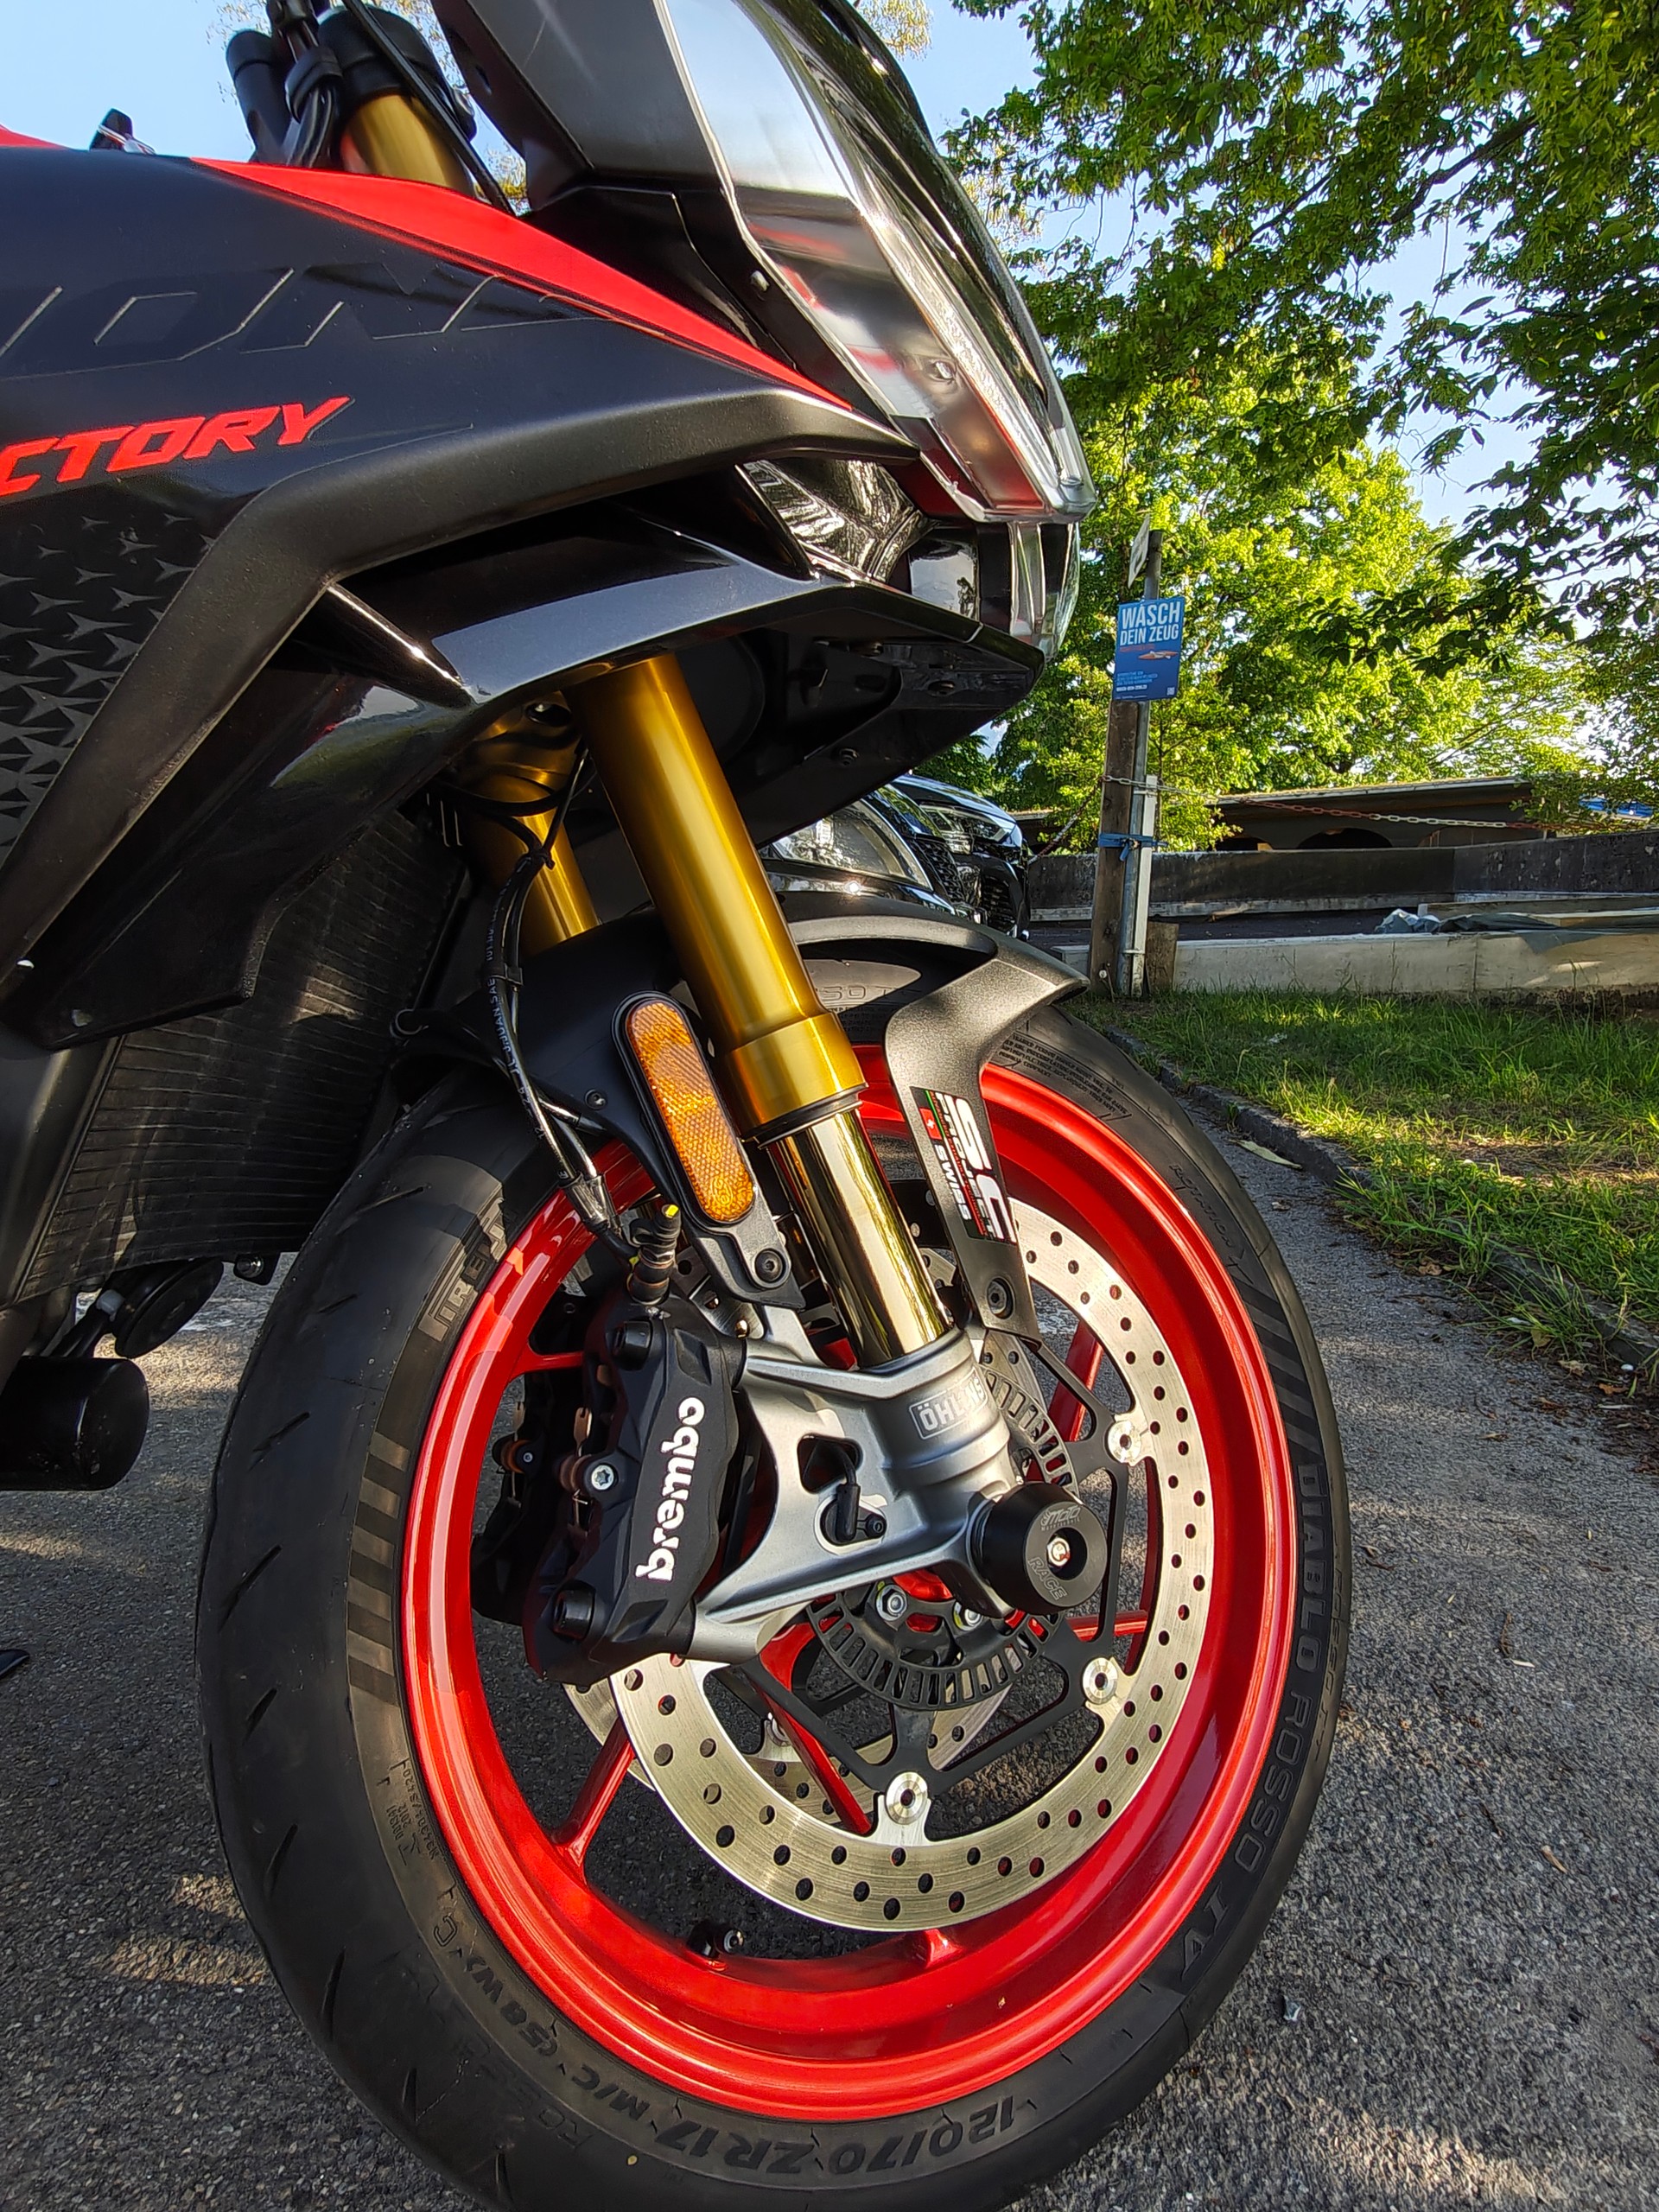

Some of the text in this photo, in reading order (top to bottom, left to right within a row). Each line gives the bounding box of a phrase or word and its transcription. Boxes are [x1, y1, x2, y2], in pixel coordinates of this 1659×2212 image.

[1120, 623, 1179, 646] DEIN ZEUG
[1122, 601, 1180, 629] WASCH
[934, 1144, 972, 1220] SWISS
[943, 1094, 1017, 1243] SC
[917, 1376, 985, 1431] ÖHLNS
[636, 1397, 705, 1581] brembo
[1028, 1556, 1068, 1600] RACE
[1296, 1463, 1328, 1672] DIABLO
[1236, 1690, 1313, 1872] ROSSO
[829, 2095, 1014, 2175] 120/70
